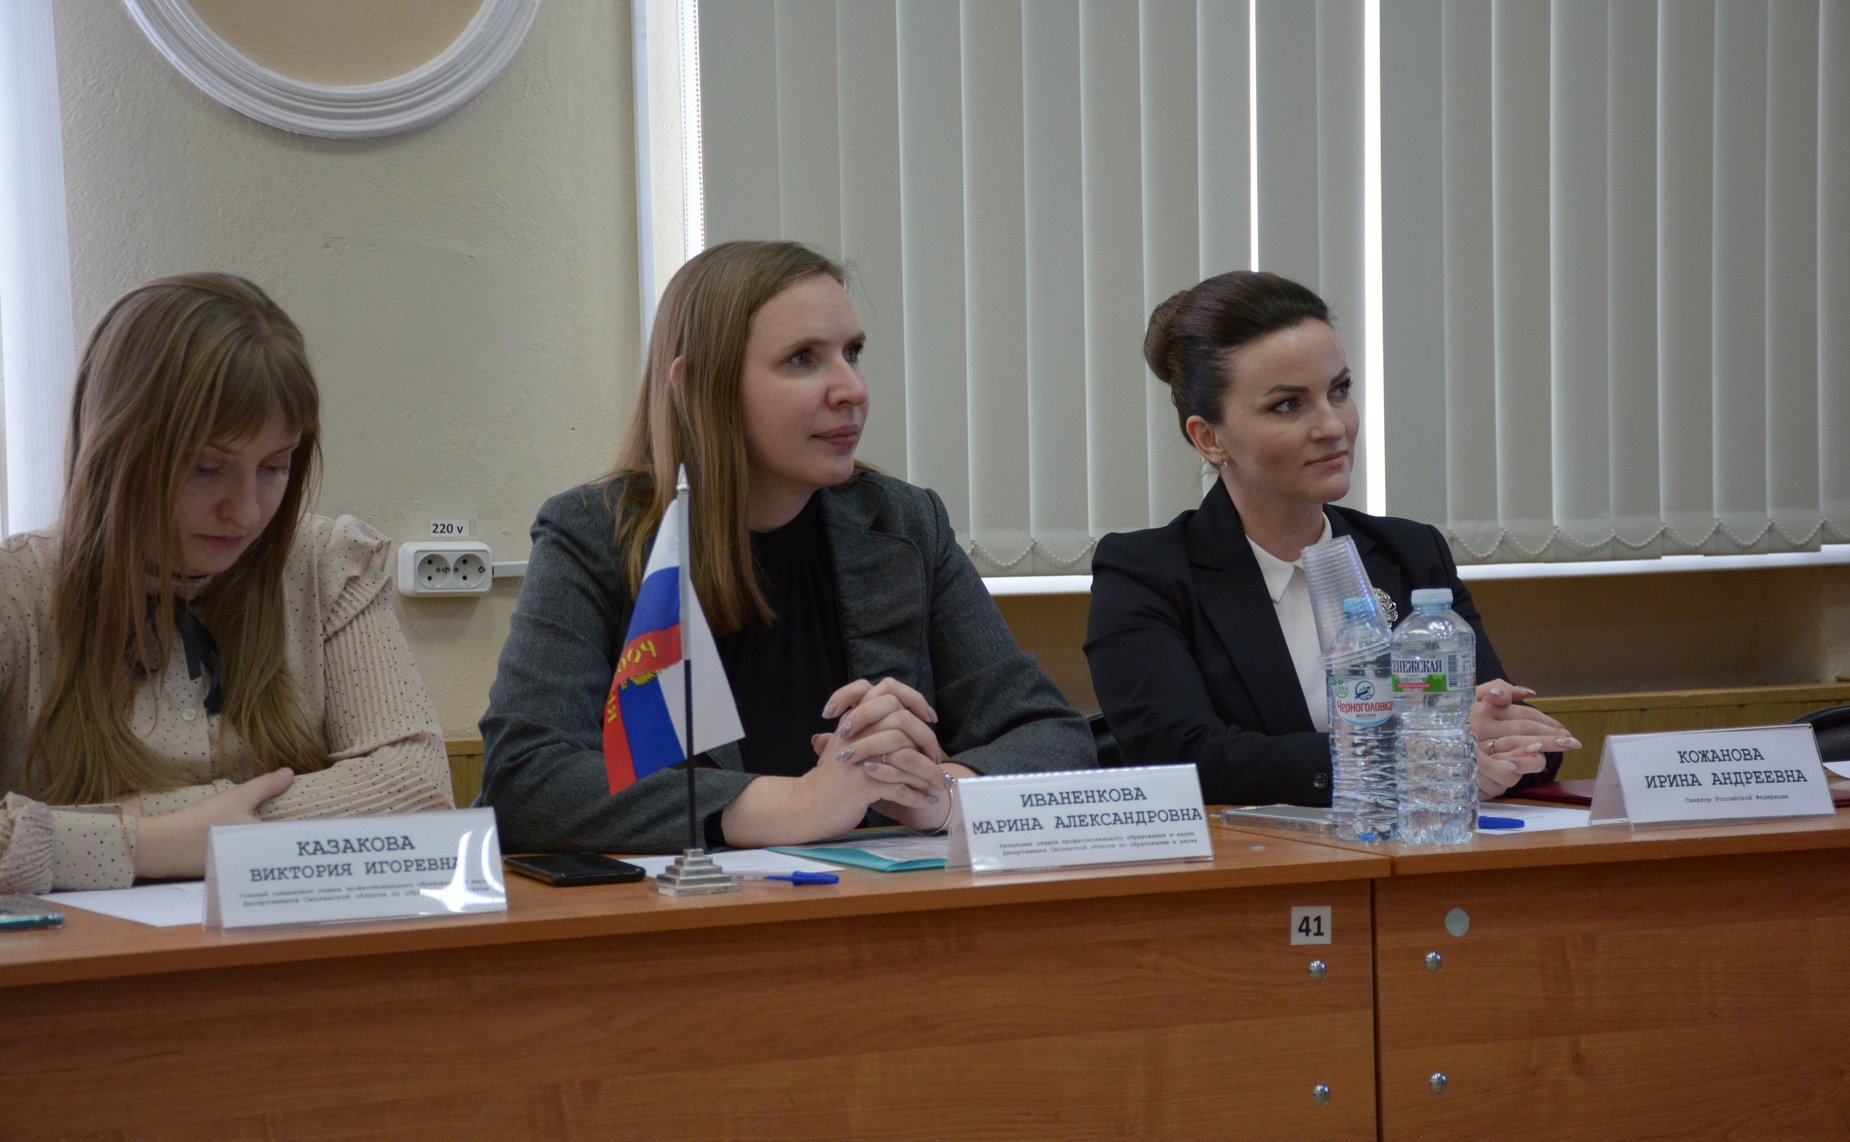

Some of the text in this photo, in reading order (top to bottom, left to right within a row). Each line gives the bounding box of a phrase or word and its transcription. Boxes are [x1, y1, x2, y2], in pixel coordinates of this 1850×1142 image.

[431, 523, 453, 534] 220
[1392, 660, 1443, 673] ЕНЕЖСКАЯ
[1336, 700, 1393, 715] Черноголовка
[1677, 748, 1765, 764] КОЖАНОВА
[1645, 769, 1808, 789] ИРИНА АНДРЕЕВНА
[1020, 787, 1147, 808] ИВАНЕНКОВА
[972, 808, 1203, 835] МАРИНА АЛЕКСАНДРОВНА
[297, 836, 416, 856] КАЗАКОВА
[250, 863, 352, 882] ВИКТОРИЯ
[1297, 915, 1325, 937] 41
